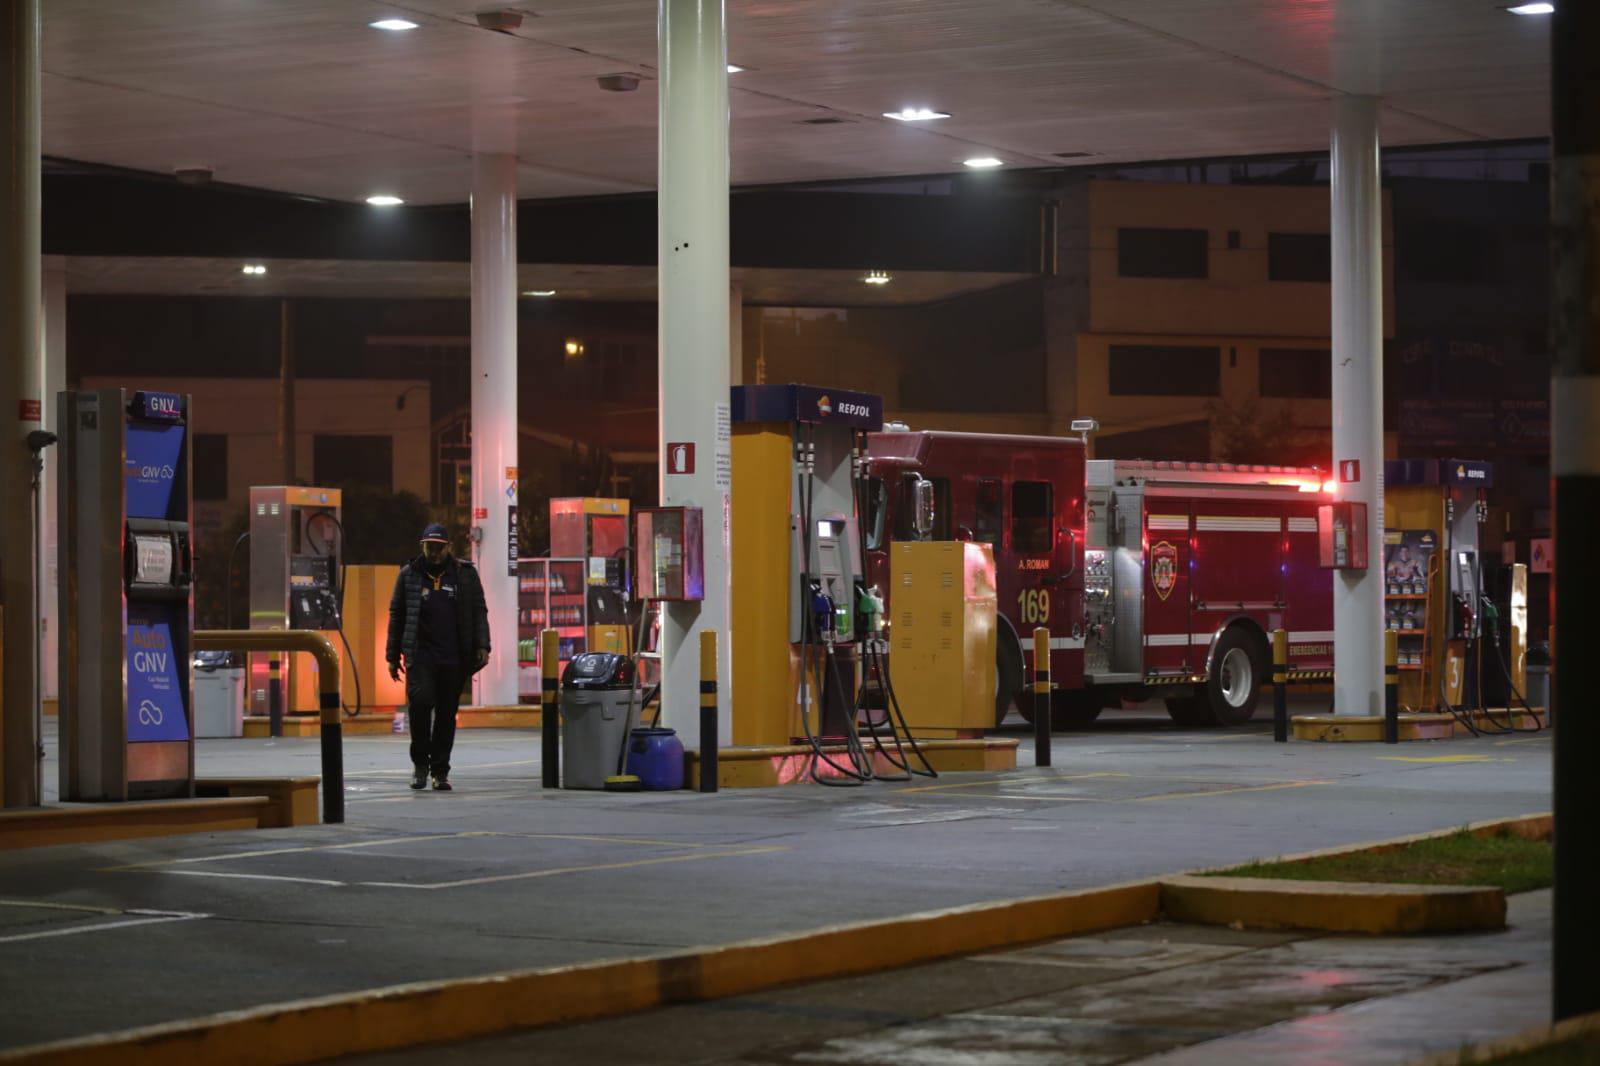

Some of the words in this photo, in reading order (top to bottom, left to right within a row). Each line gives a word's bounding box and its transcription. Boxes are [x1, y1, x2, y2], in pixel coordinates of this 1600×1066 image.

[151, 396, 174, 412] GNV
[838, 402, 870, 417] REPSOL
[1026, 560, 1050, 569] ROMAN
[1017, 588, 1050, 623] 169
[132, 625, 166, 649] Auto
[134, 651, 167, 673] GNV
[1450, 656, 1459, 688] 3
